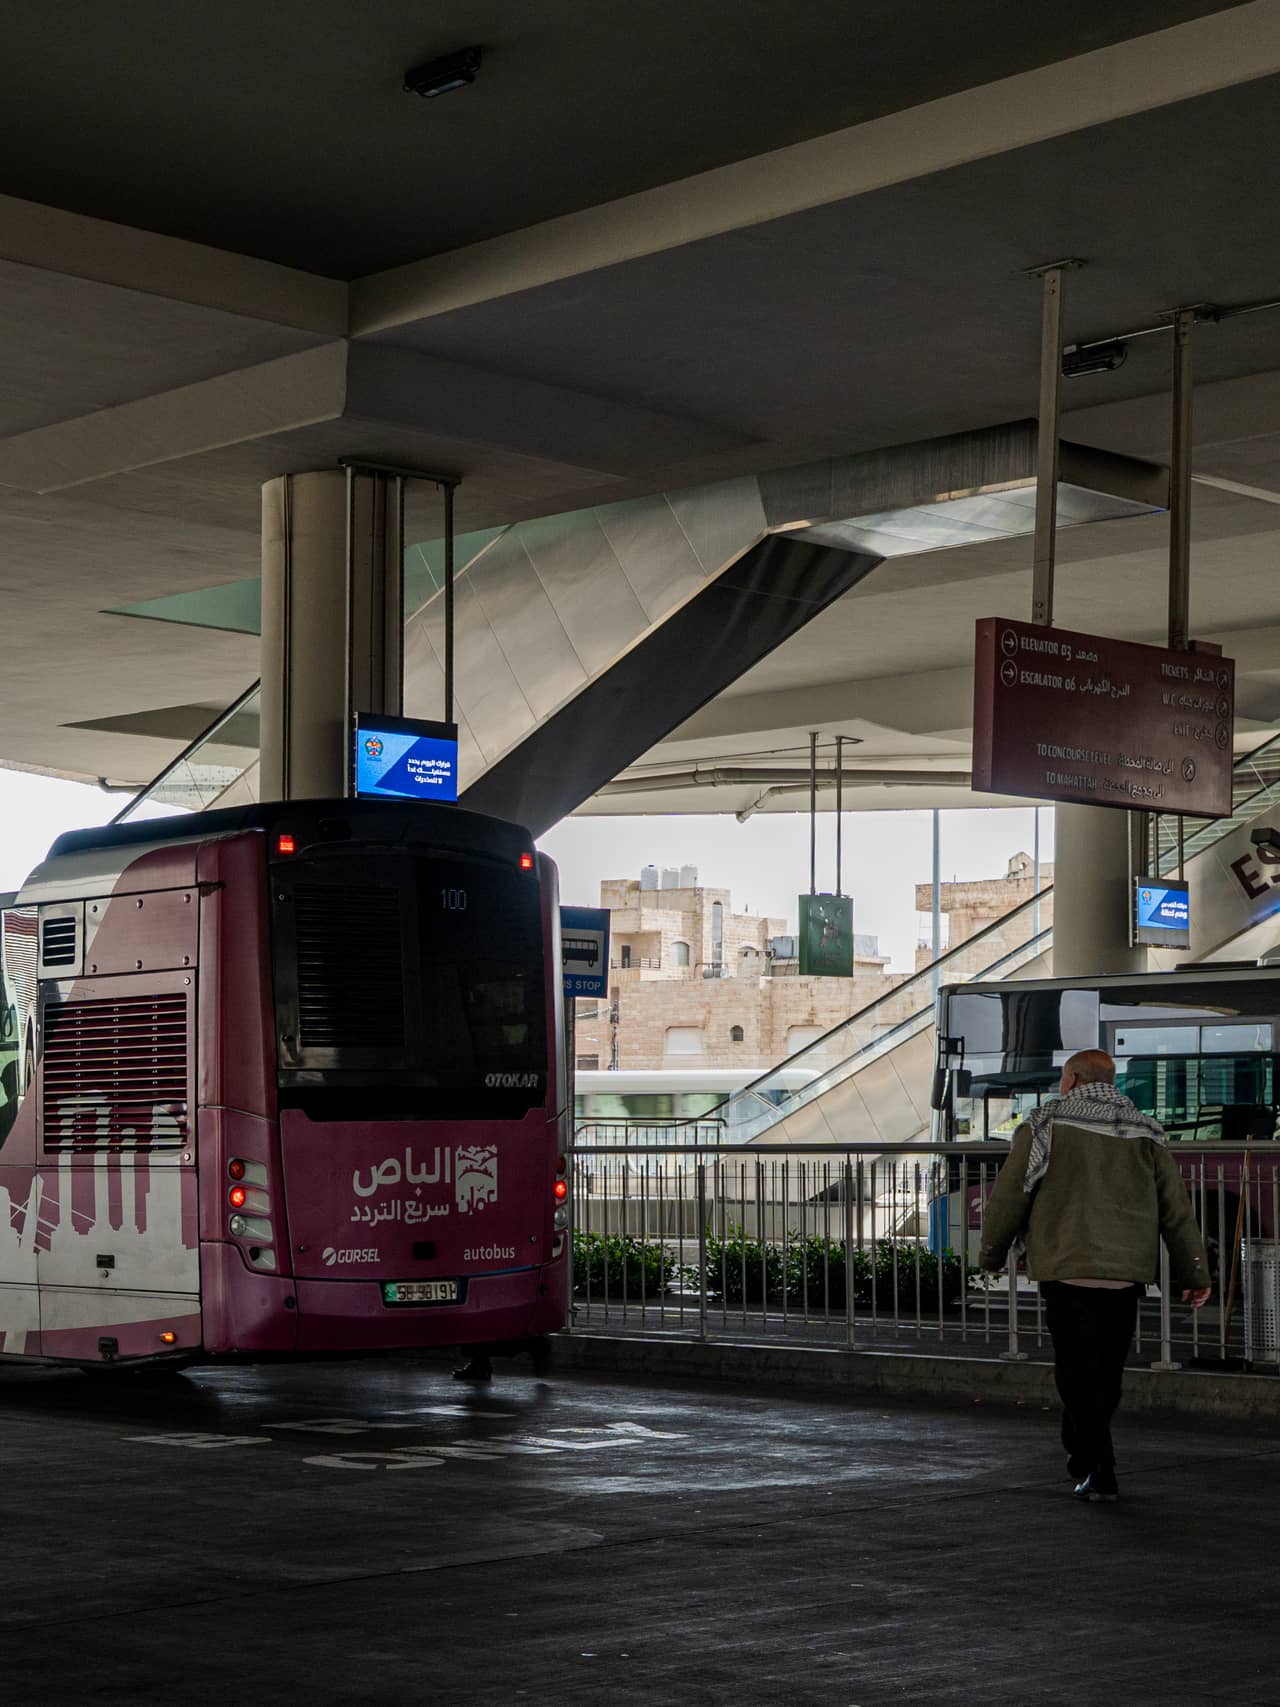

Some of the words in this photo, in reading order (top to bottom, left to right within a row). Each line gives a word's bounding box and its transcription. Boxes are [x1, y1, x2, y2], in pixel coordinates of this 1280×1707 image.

[1020, 636, 1059, 656] ELEVATOR
[1061, 644, 1072, 661] 03
[1020, 670, 1063, 689] ESCALATOR
[1065, 676, 1076, 691] 06
[1036, 743, 1047, 757] TO
[1047, 745, 1090, 762] CONCOURSE
[1090, 751, 1111, 765] LEVEL
[1046, 771, 1056, 785] TO
[440, 888, 467, 910] 100
[575, 980, 601, 991] STOP
[485, 1073, 539, 1088] OTOKAR
[352, 1146, 451, 1197] الباص
[350, 1199, 401, 1227] التردد
[404, 1199, 450, 1225] سريع
[463, 1243, 515, 1261] autobus
